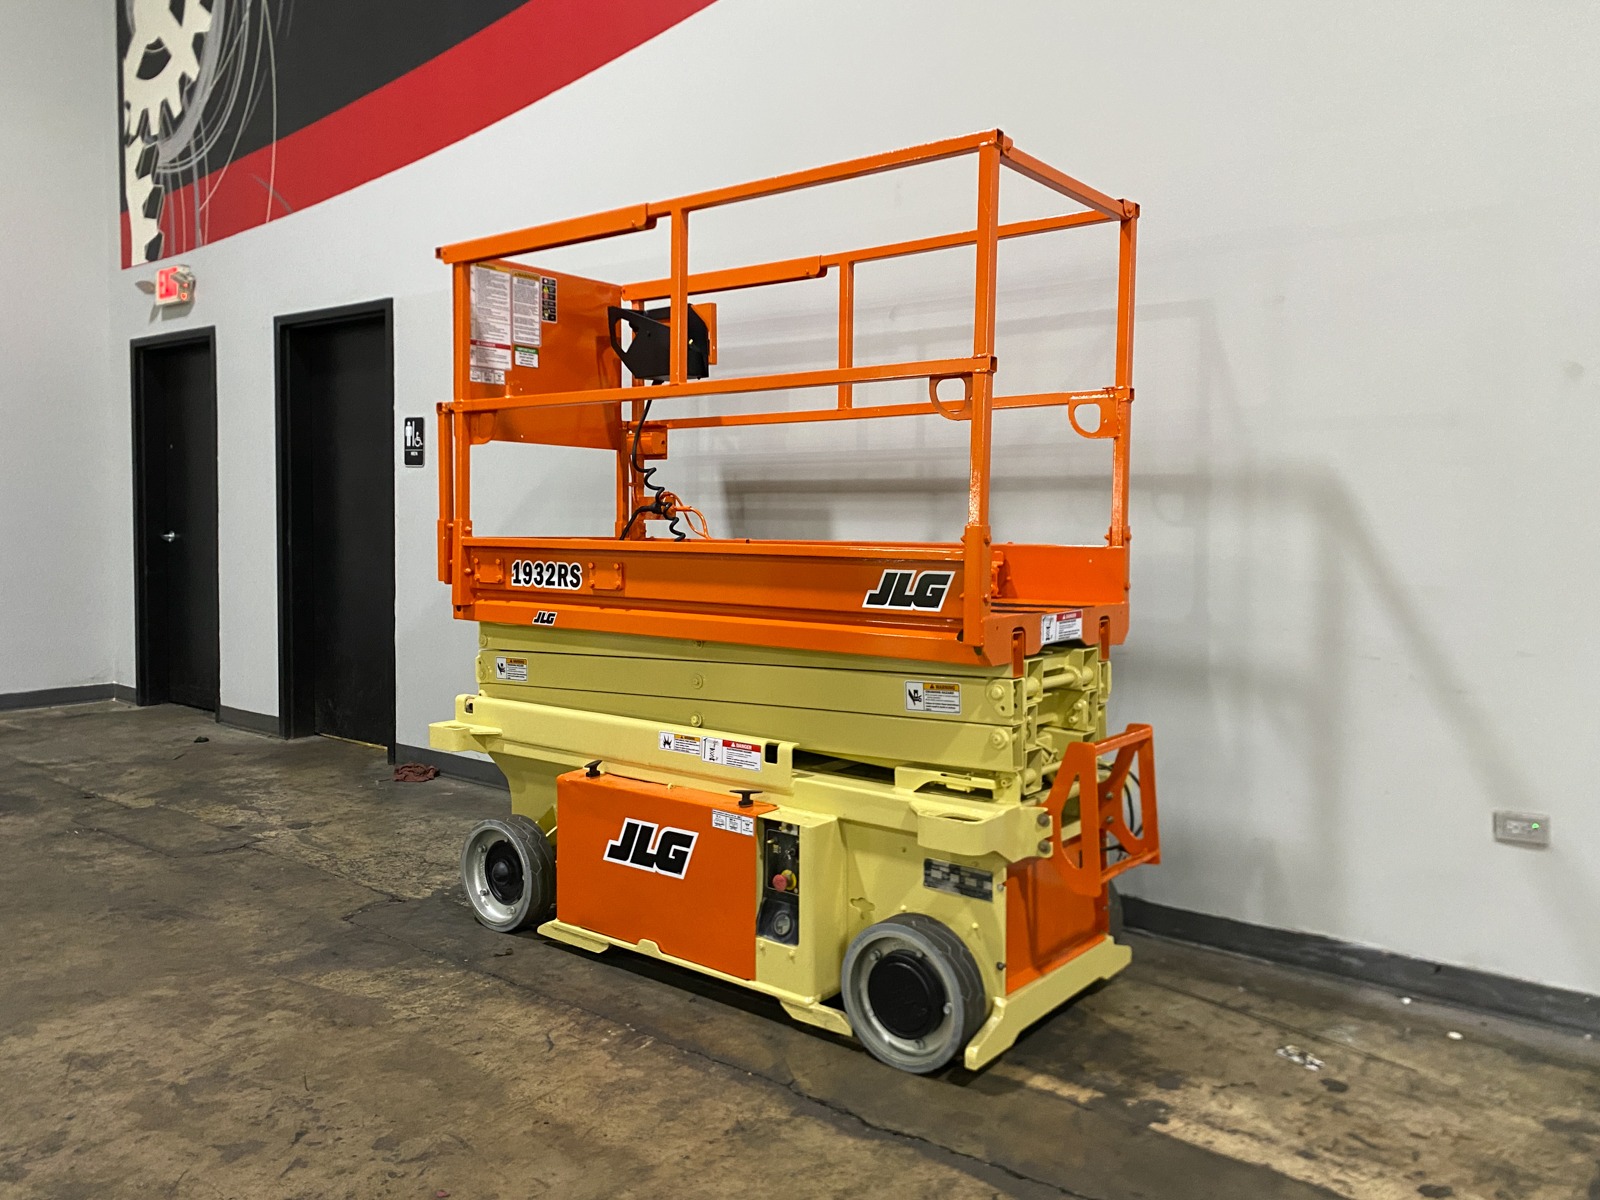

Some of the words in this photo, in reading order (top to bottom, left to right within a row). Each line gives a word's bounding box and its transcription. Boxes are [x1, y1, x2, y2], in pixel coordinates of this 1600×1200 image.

[512, 561, 582, 588] 1932RS
[865, 572, 952, 608] JLG
[533, 611, 556, 625] JLG
[606, 821, 695, 876] JLG
